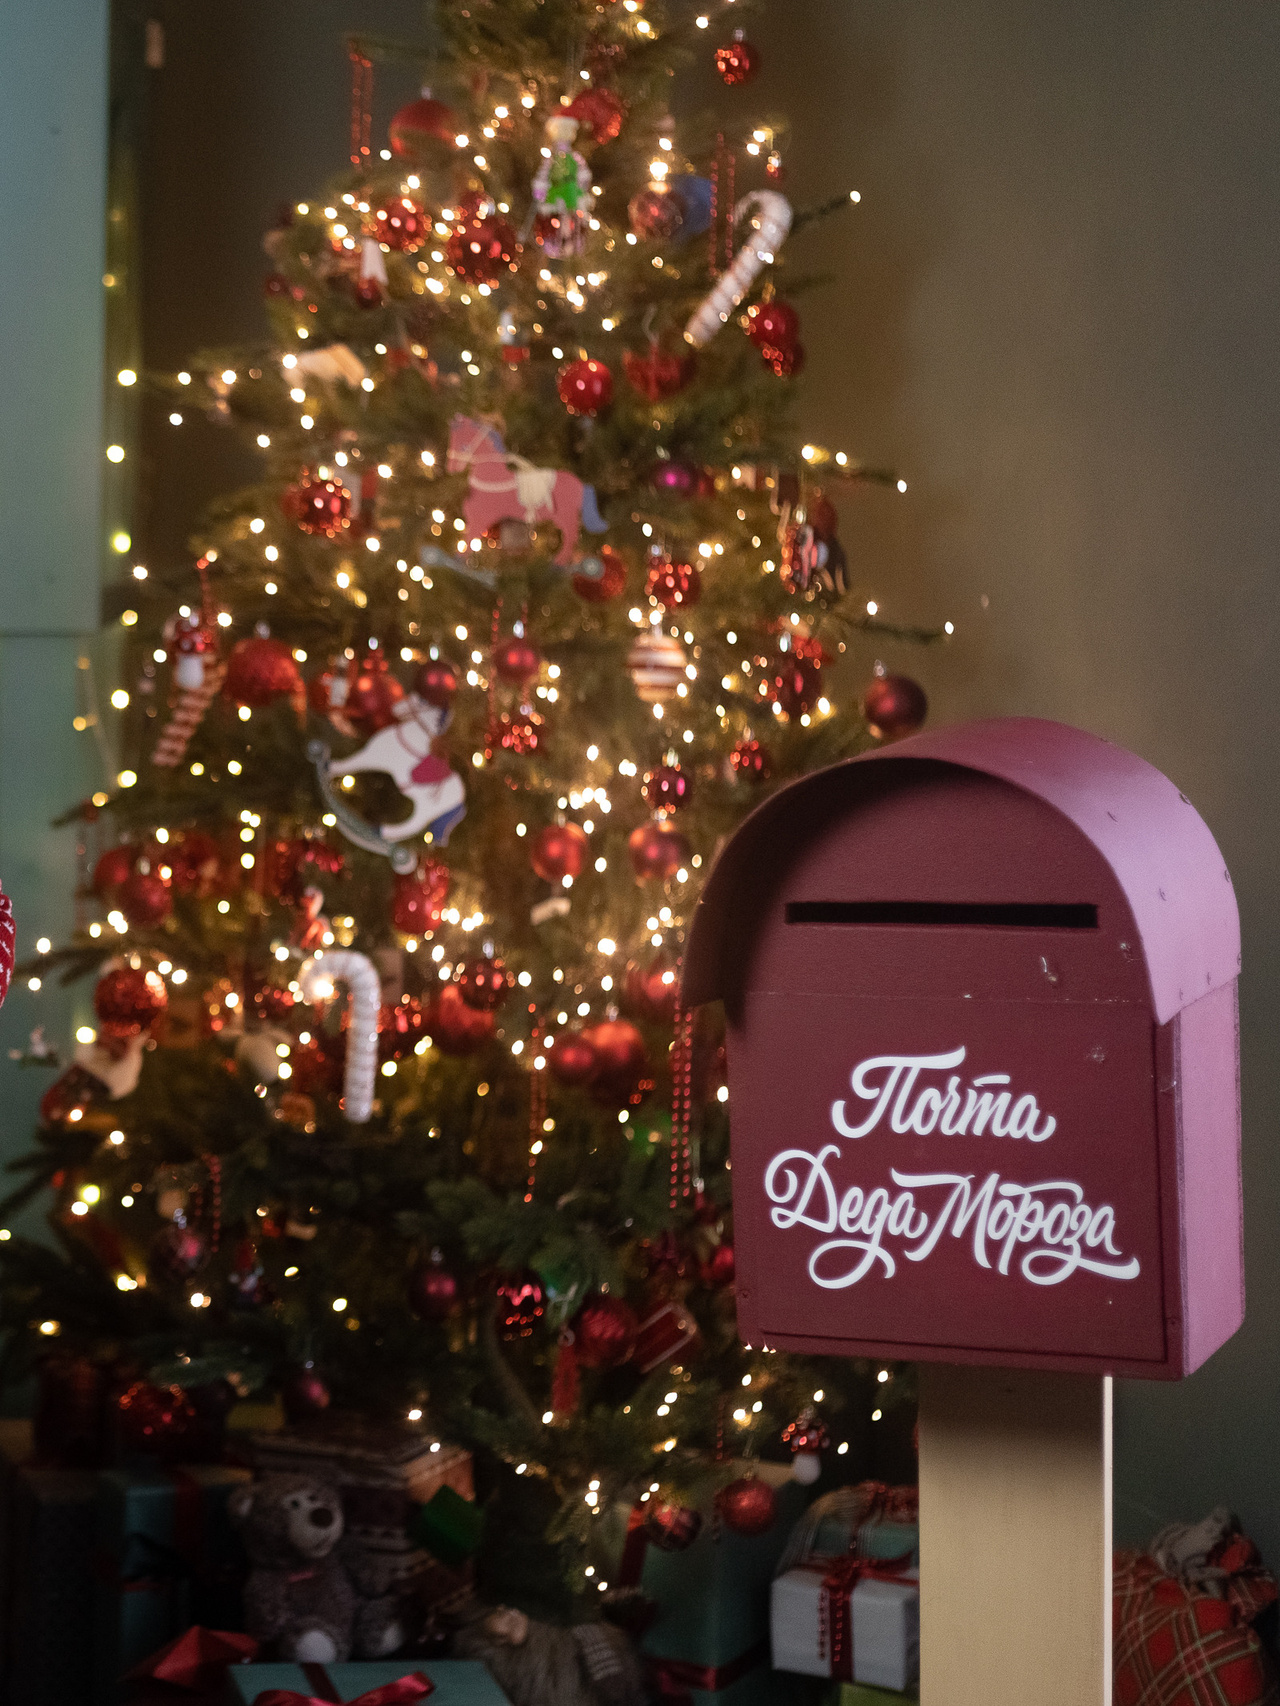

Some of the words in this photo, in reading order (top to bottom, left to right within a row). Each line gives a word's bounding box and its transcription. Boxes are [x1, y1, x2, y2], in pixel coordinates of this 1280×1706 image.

[831, 1045, 1057, 1142] Почта
[764, 1144, 929, 1290] Деда
[891, 1167, 1141, 1286] Мороза
